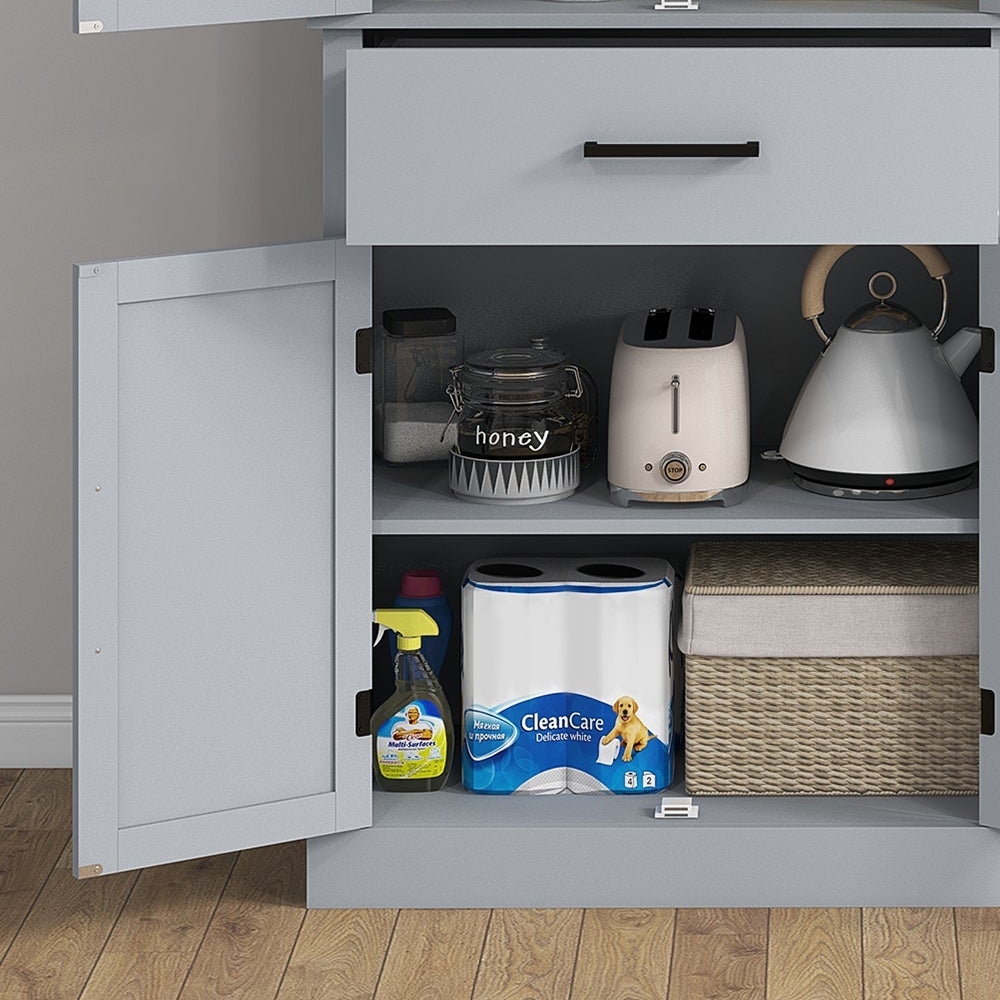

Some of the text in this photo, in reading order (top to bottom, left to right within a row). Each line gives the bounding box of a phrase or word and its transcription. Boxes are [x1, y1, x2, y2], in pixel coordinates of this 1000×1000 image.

[476, 425, 550, 452] honey
[473, 720, 500, 730] Мягкая
[521, 712, 604, 732] CleanCare
[475, 733, 506, 742] прочная
[536, 732, 592, 742] Delicate white
[627, 777, 632, 785] 4
[647, 777, 652, 785] 2
